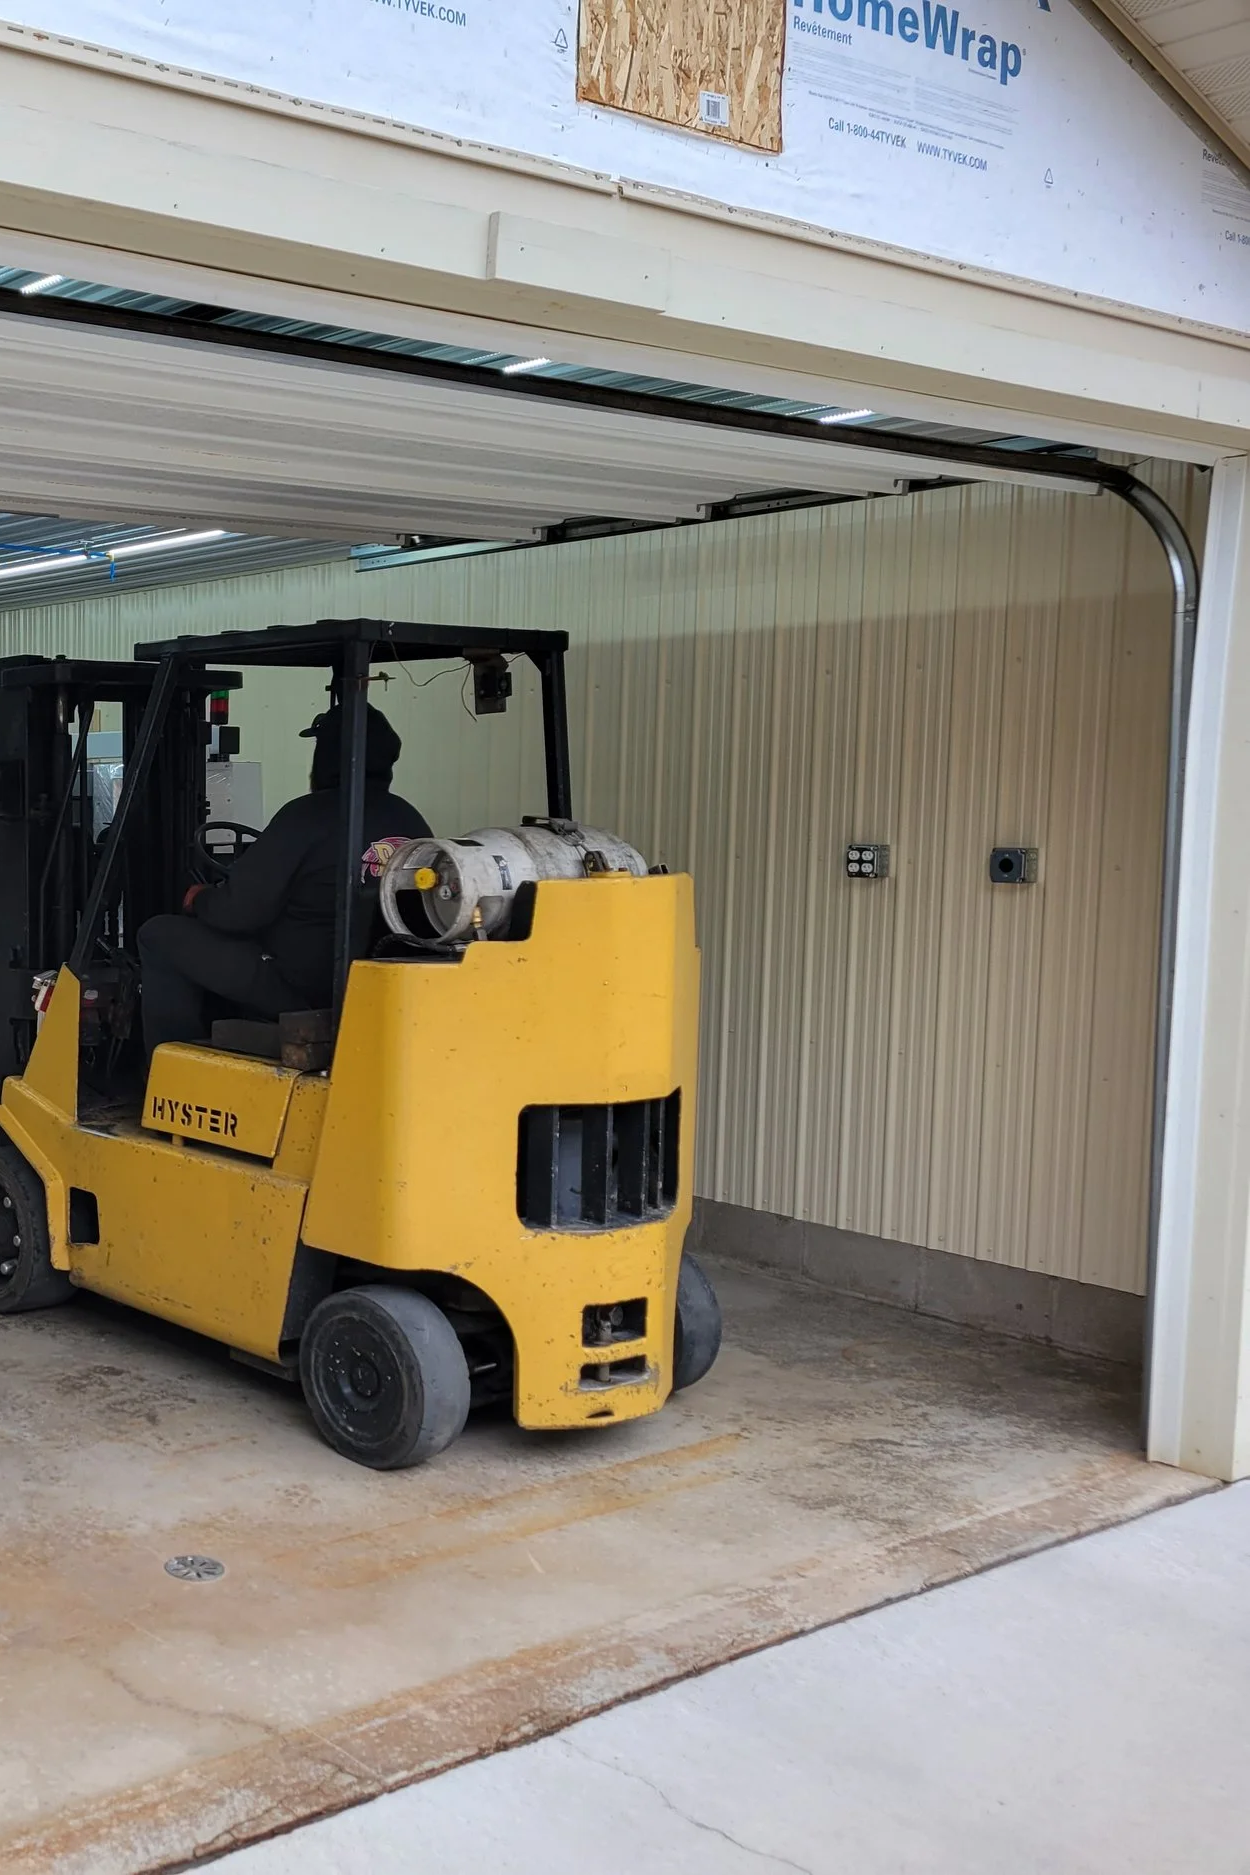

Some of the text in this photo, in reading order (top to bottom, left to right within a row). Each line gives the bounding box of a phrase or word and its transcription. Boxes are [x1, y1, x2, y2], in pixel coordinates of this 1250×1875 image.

[793, 15, 853, 46] Revêtement
[794, 0, 1022, 86] omeWrap
[828, 117, 844, 132] Call
[846, 122, 907, 149] 1-800-44TYVEK
[916, 140, 988, 171] WWW.TYVEK.COM
[152, 1096, 238, 1138] HYSTER
